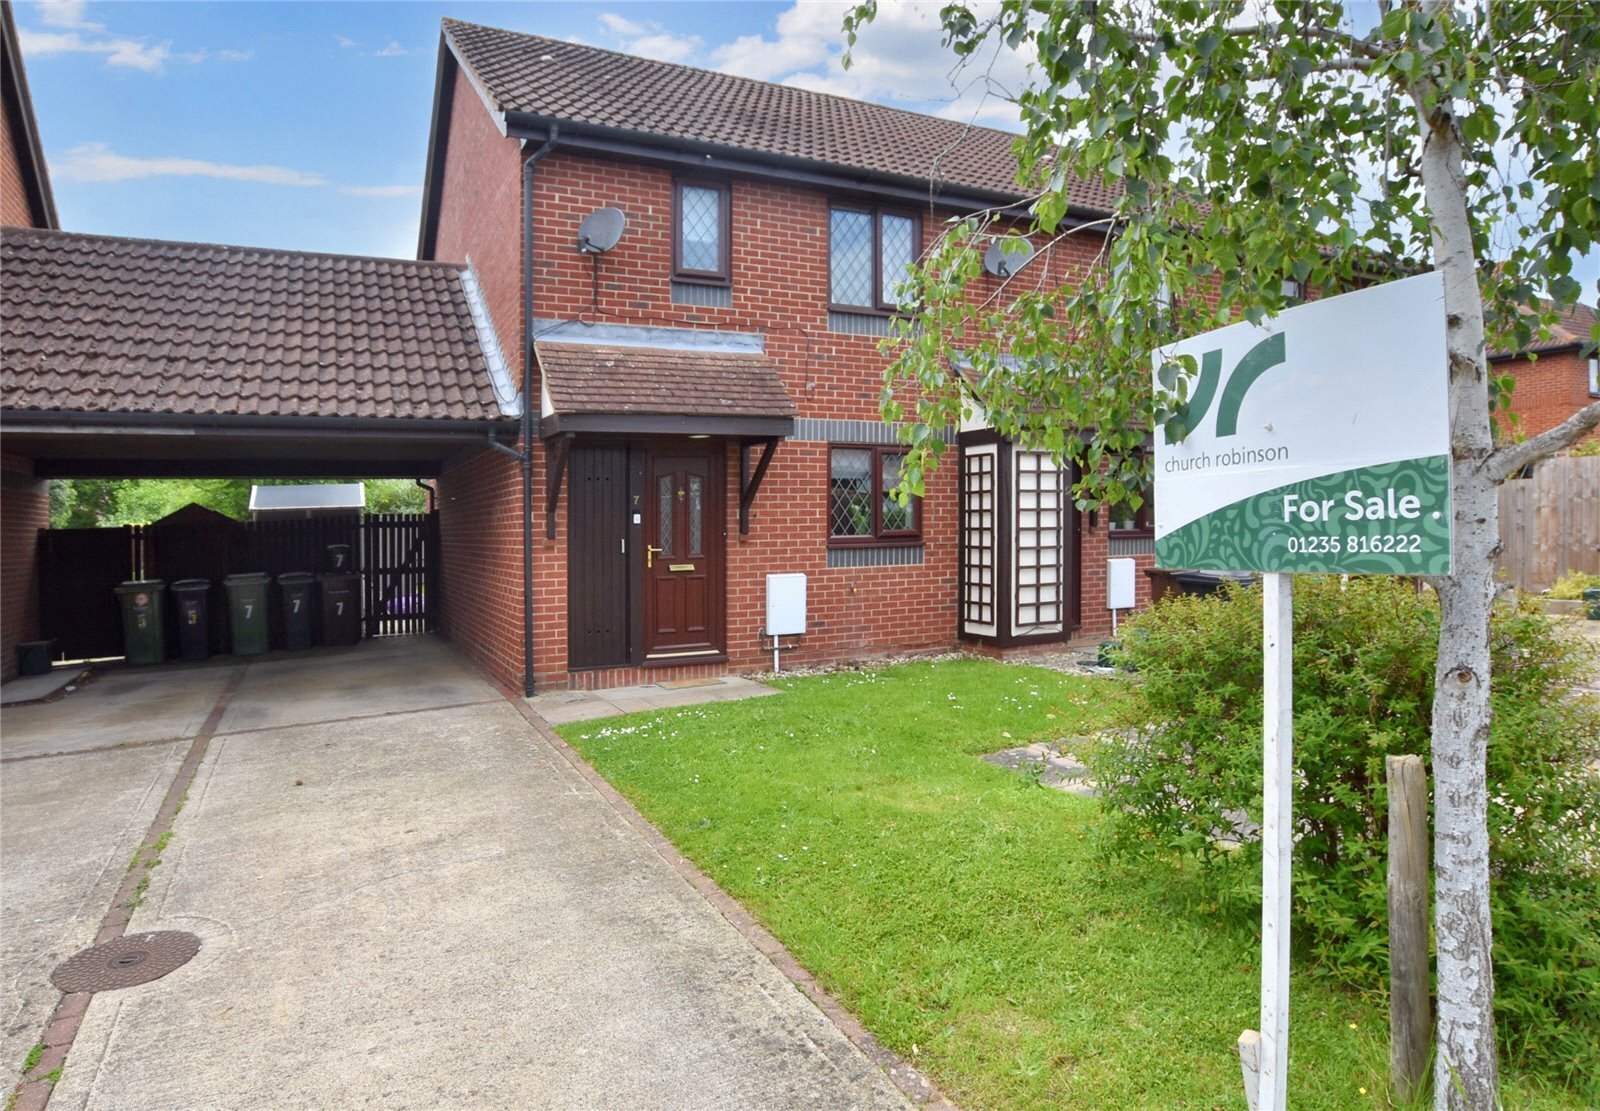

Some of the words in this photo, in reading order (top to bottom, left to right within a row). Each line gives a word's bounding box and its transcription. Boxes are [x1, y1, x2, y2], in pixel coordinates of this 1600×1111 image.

[1164, 451, 1211, 473] church
[1215, 446, 1289, 467] robinson
[632, 495, 640, 505] 7
[1283, 494, 1335, 523] For
[1287, 535, 1341, 554] 01235
[1346, 534, 1422, 553] 816222
[336, 554, 344, 567] 7
[245, 604, 253, 619] 7
[293, 599, 301, 613] 7
[336, 602, 344, 616] 7
